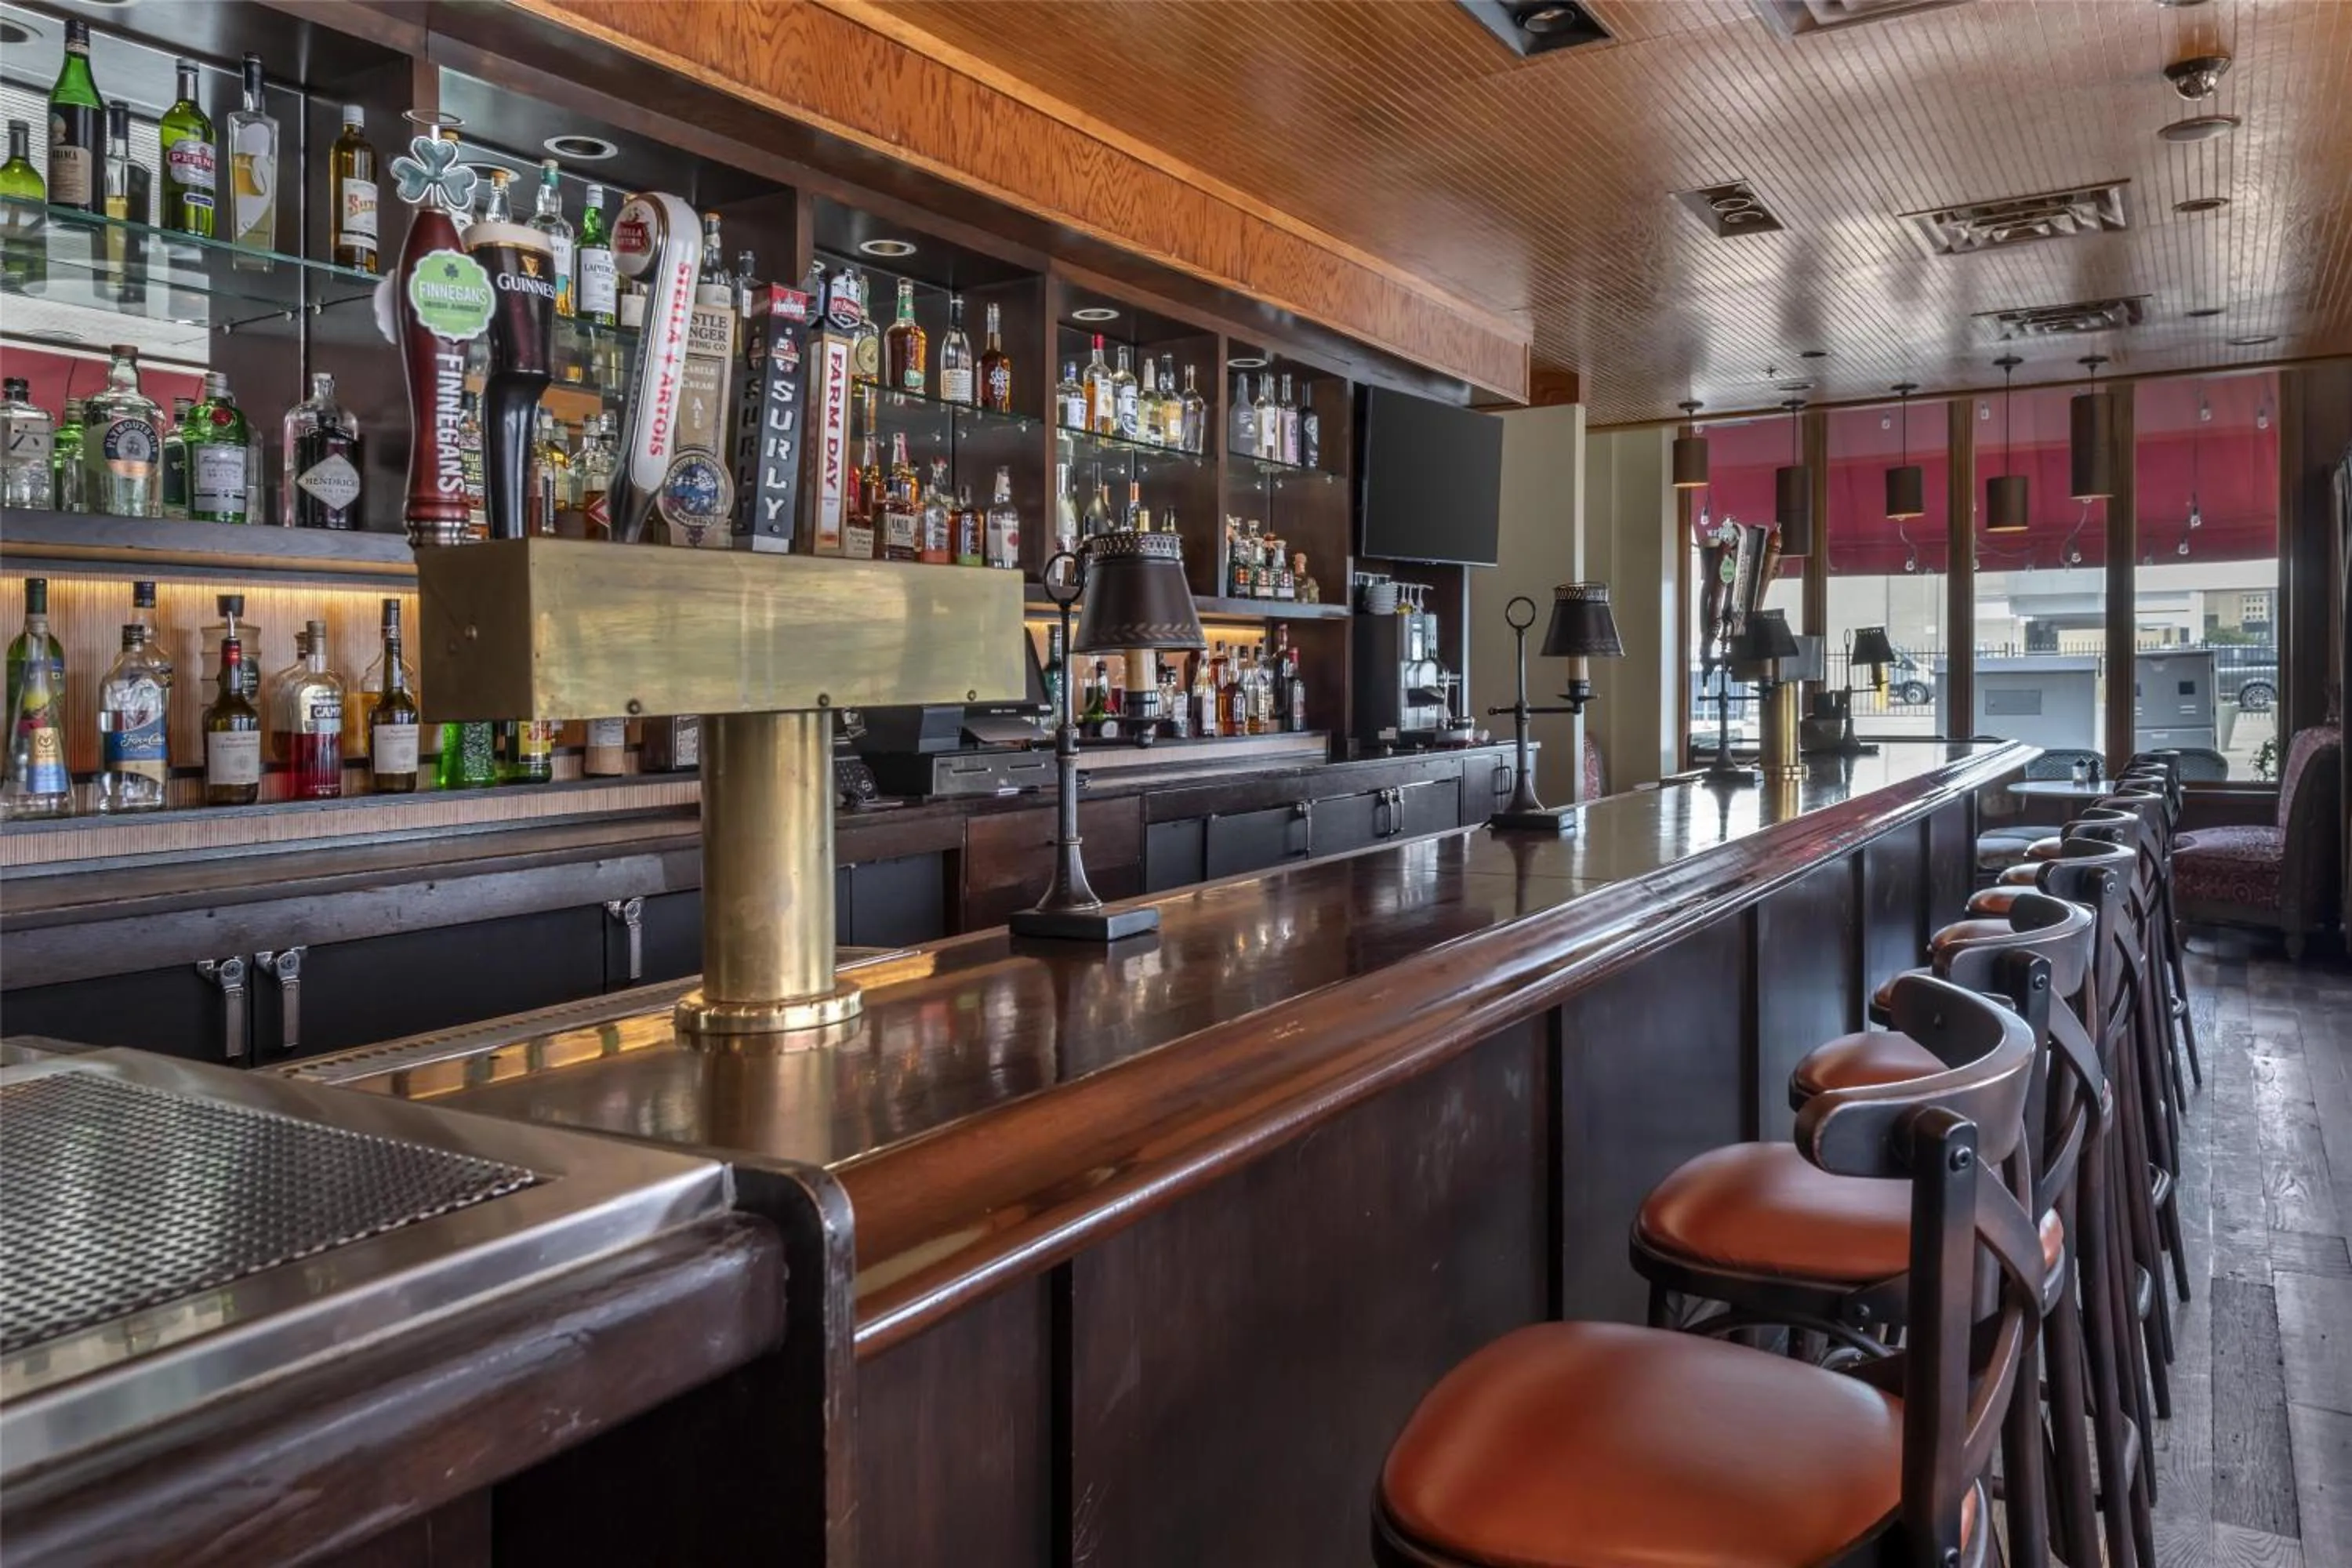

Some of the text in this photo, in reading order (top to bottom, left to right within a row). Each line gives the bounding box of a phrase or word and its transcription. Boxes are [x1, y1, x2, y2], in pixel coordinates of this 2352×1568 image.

[418, 281, 488, 305] FINNEGANS
[691, 312, 728, 328] STLE
[650, 262, 692, 456] STELLA ARTOIS
[688, 341, 712, 350] WING
[689, 325, 727, 343] NGER
[828, 353, 842, 429] FARM
[436, 353, 466, 495] FINNEGANS
[765, 380, 796, 521] SURLY
[826, 437, 840, 491] DAY
